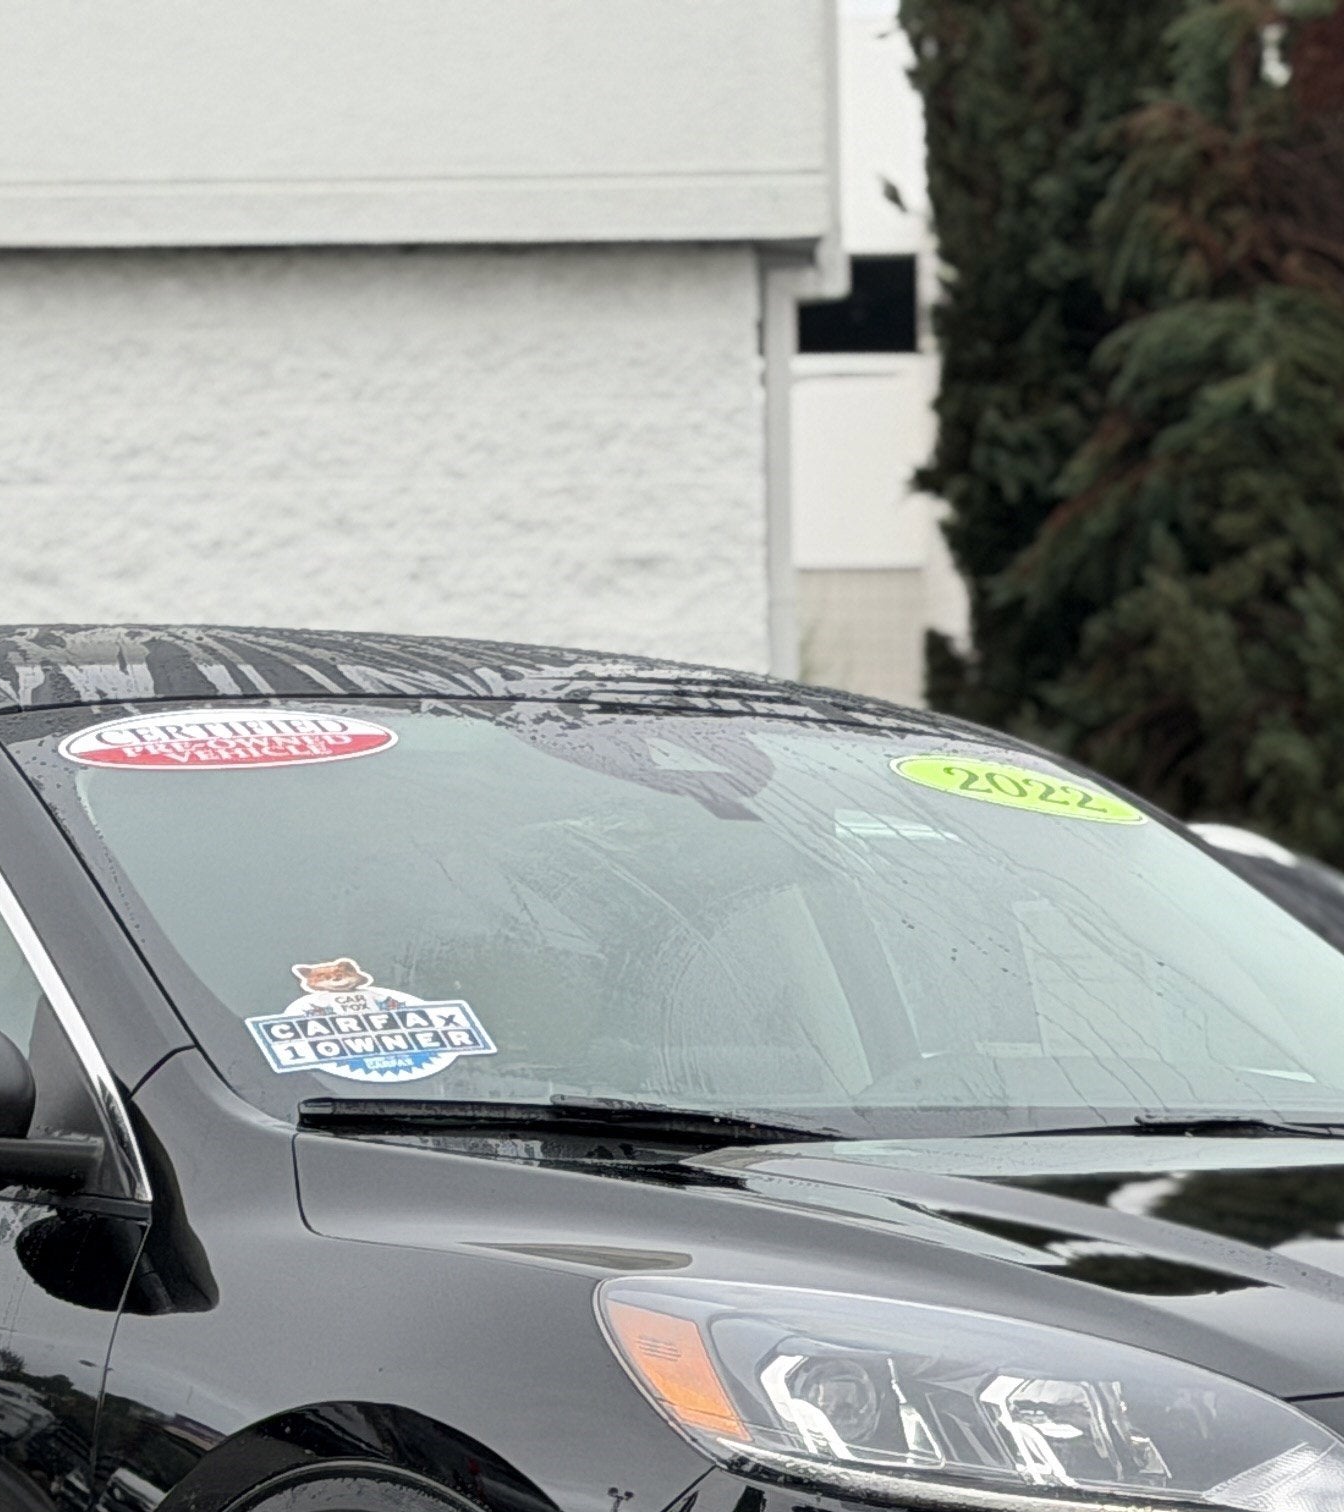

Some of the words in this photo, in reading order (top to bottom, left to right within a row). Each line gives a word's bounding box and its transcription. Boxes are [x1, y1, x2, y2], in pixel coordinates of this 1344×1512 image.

[96, 718, 349, 746] CERTIFIED
[121, 733, 352, 758] PRE-OWNED
[167, 741, 334, 764] VEHICLE
[942, 767, 1108, 814] 2022
[270, 1010, 463, 1040] CARFAX
[282, 1045, 304, 1061] 1
[316, 1029, 475, 1057] OWNER
